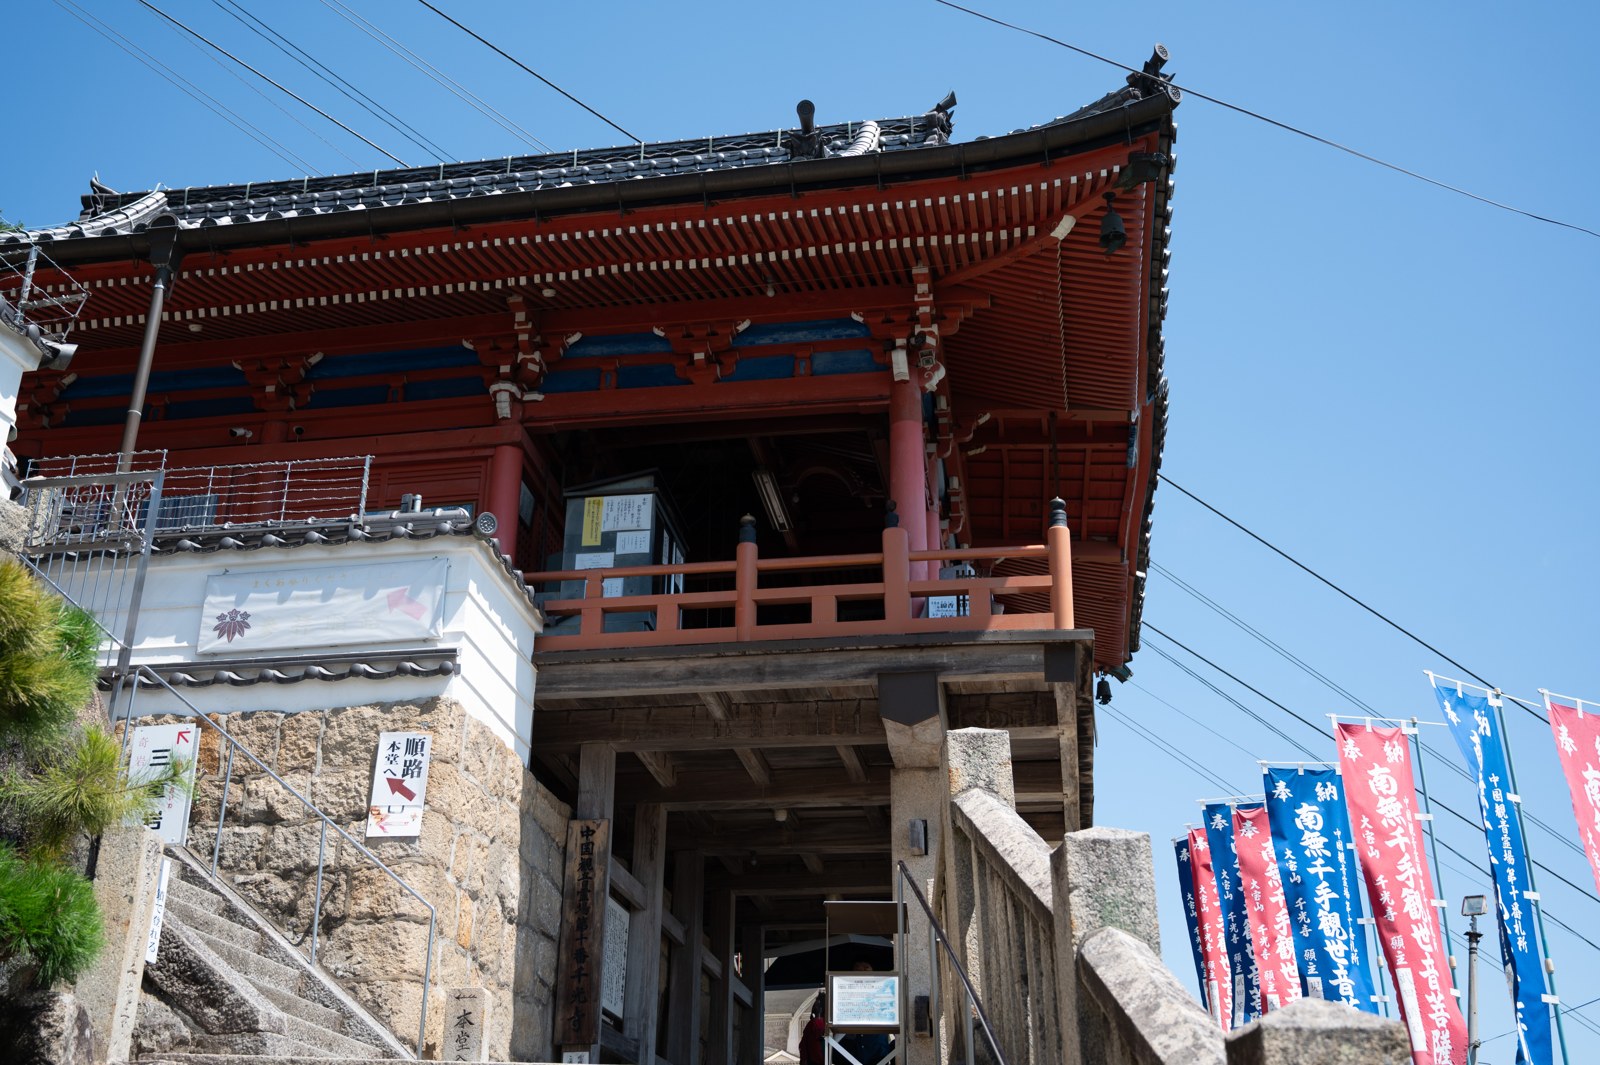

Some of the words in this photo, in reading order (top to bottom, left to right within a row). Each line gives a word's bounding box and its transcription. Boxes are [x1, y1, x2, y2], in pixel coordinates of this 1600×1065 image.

[383, 740, 402, 777] 本堂へ
[401, 736, 427, 779] 順路
[1488, 773, 1528, 954] 中国観音霊場第十番札所
[1295, 897, 1312, 938] 千光寺
[1367, 762, 1454, 1065] 南無千手観世音菩薩
[1375, 874, 1398, 922] 千光寺
